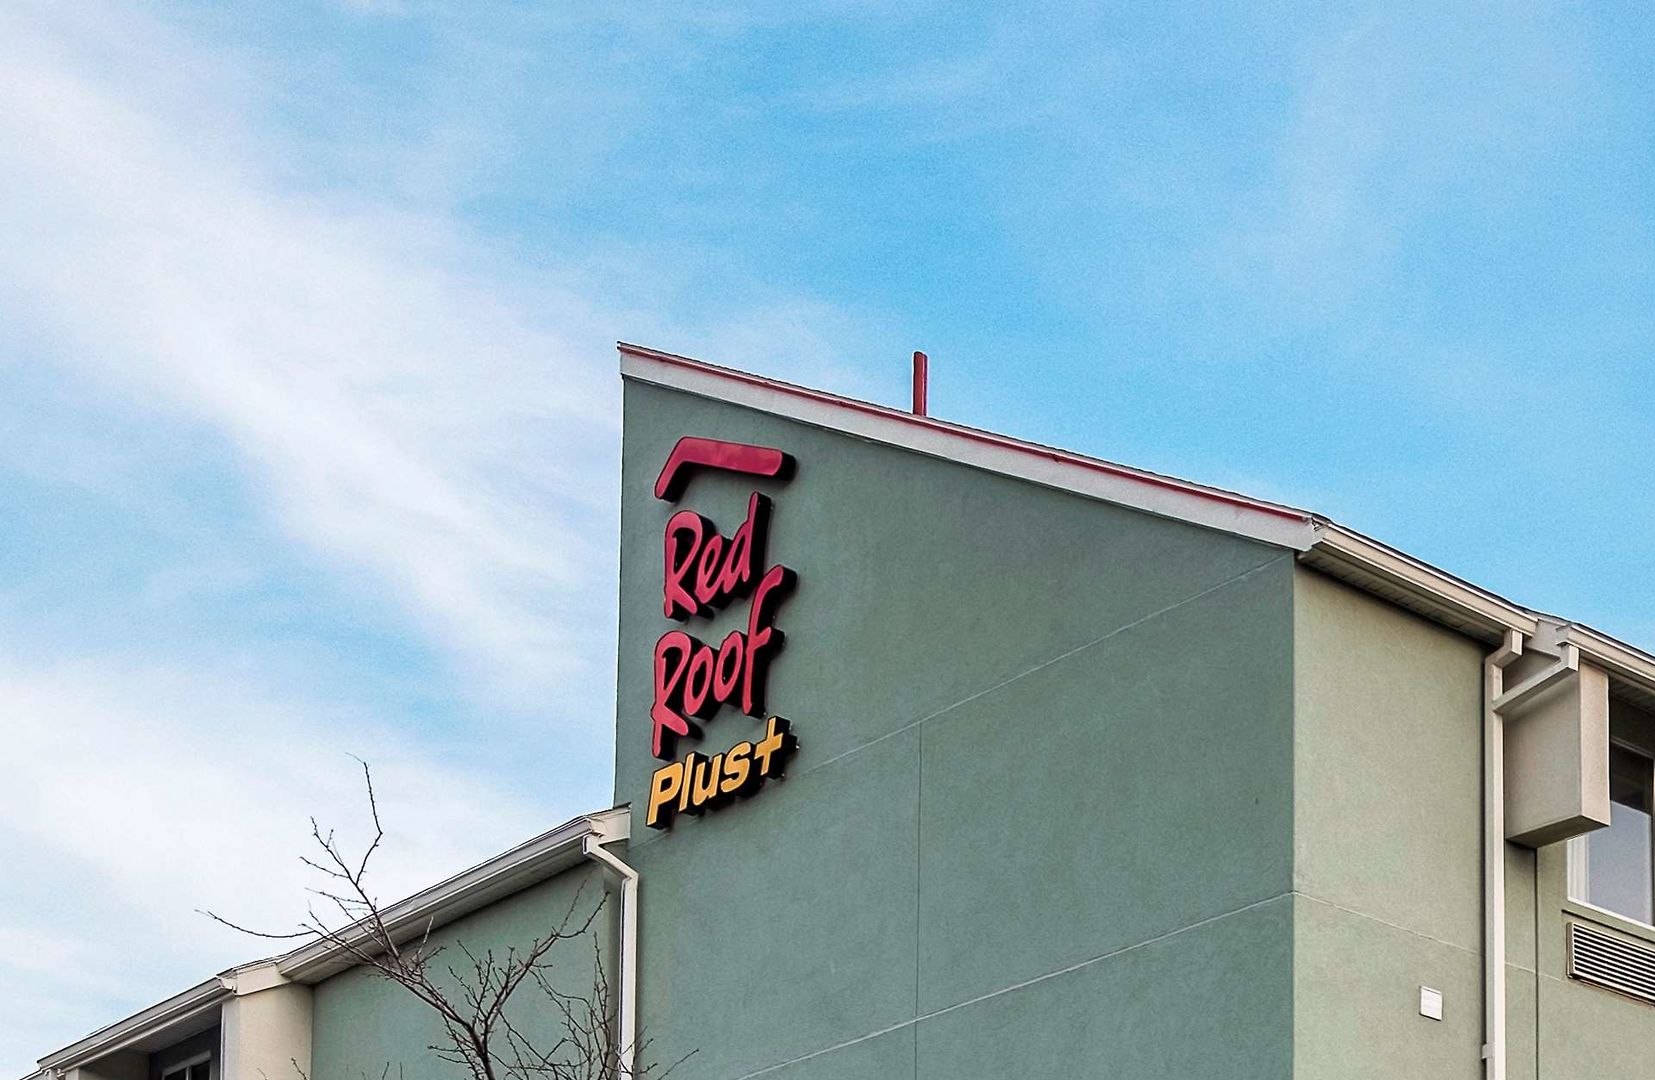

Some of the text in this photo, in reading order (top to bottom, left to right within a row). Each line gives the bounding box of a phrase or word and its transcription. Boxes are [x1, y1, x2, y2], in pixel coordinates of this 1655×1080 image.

[664, 490, 765, 620] Red
[650, 563, 790, 759] Roof
[646, 716, 792, 828] Plus+
